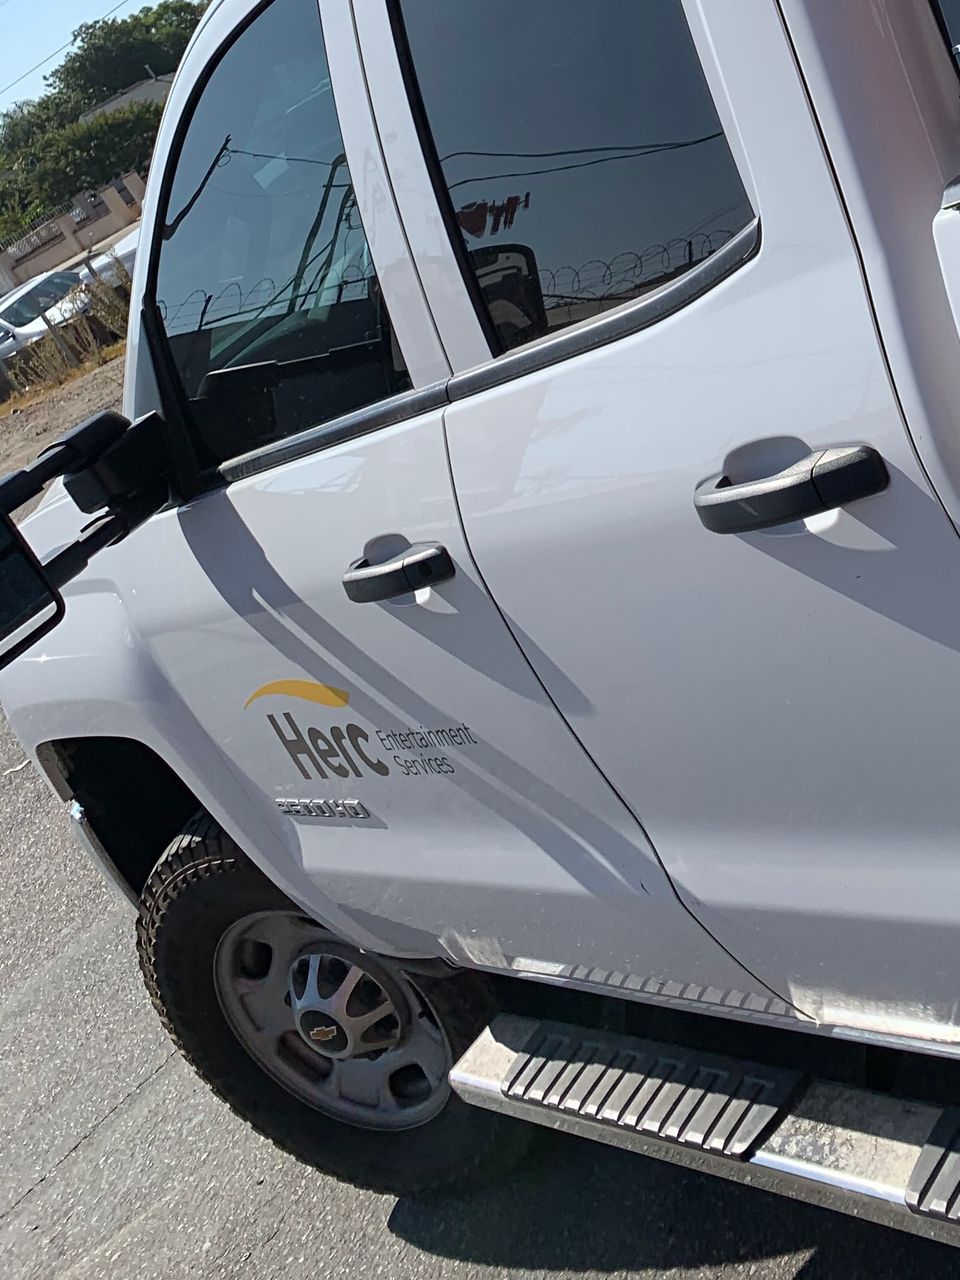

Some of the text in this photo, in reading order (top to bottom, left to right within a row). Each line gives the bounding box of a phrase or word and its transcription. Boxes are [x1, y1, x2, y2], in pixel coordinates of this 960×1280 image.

[266, 711, 478, 780] Herc Entertainment
[393, 753, 455, 776] Services
